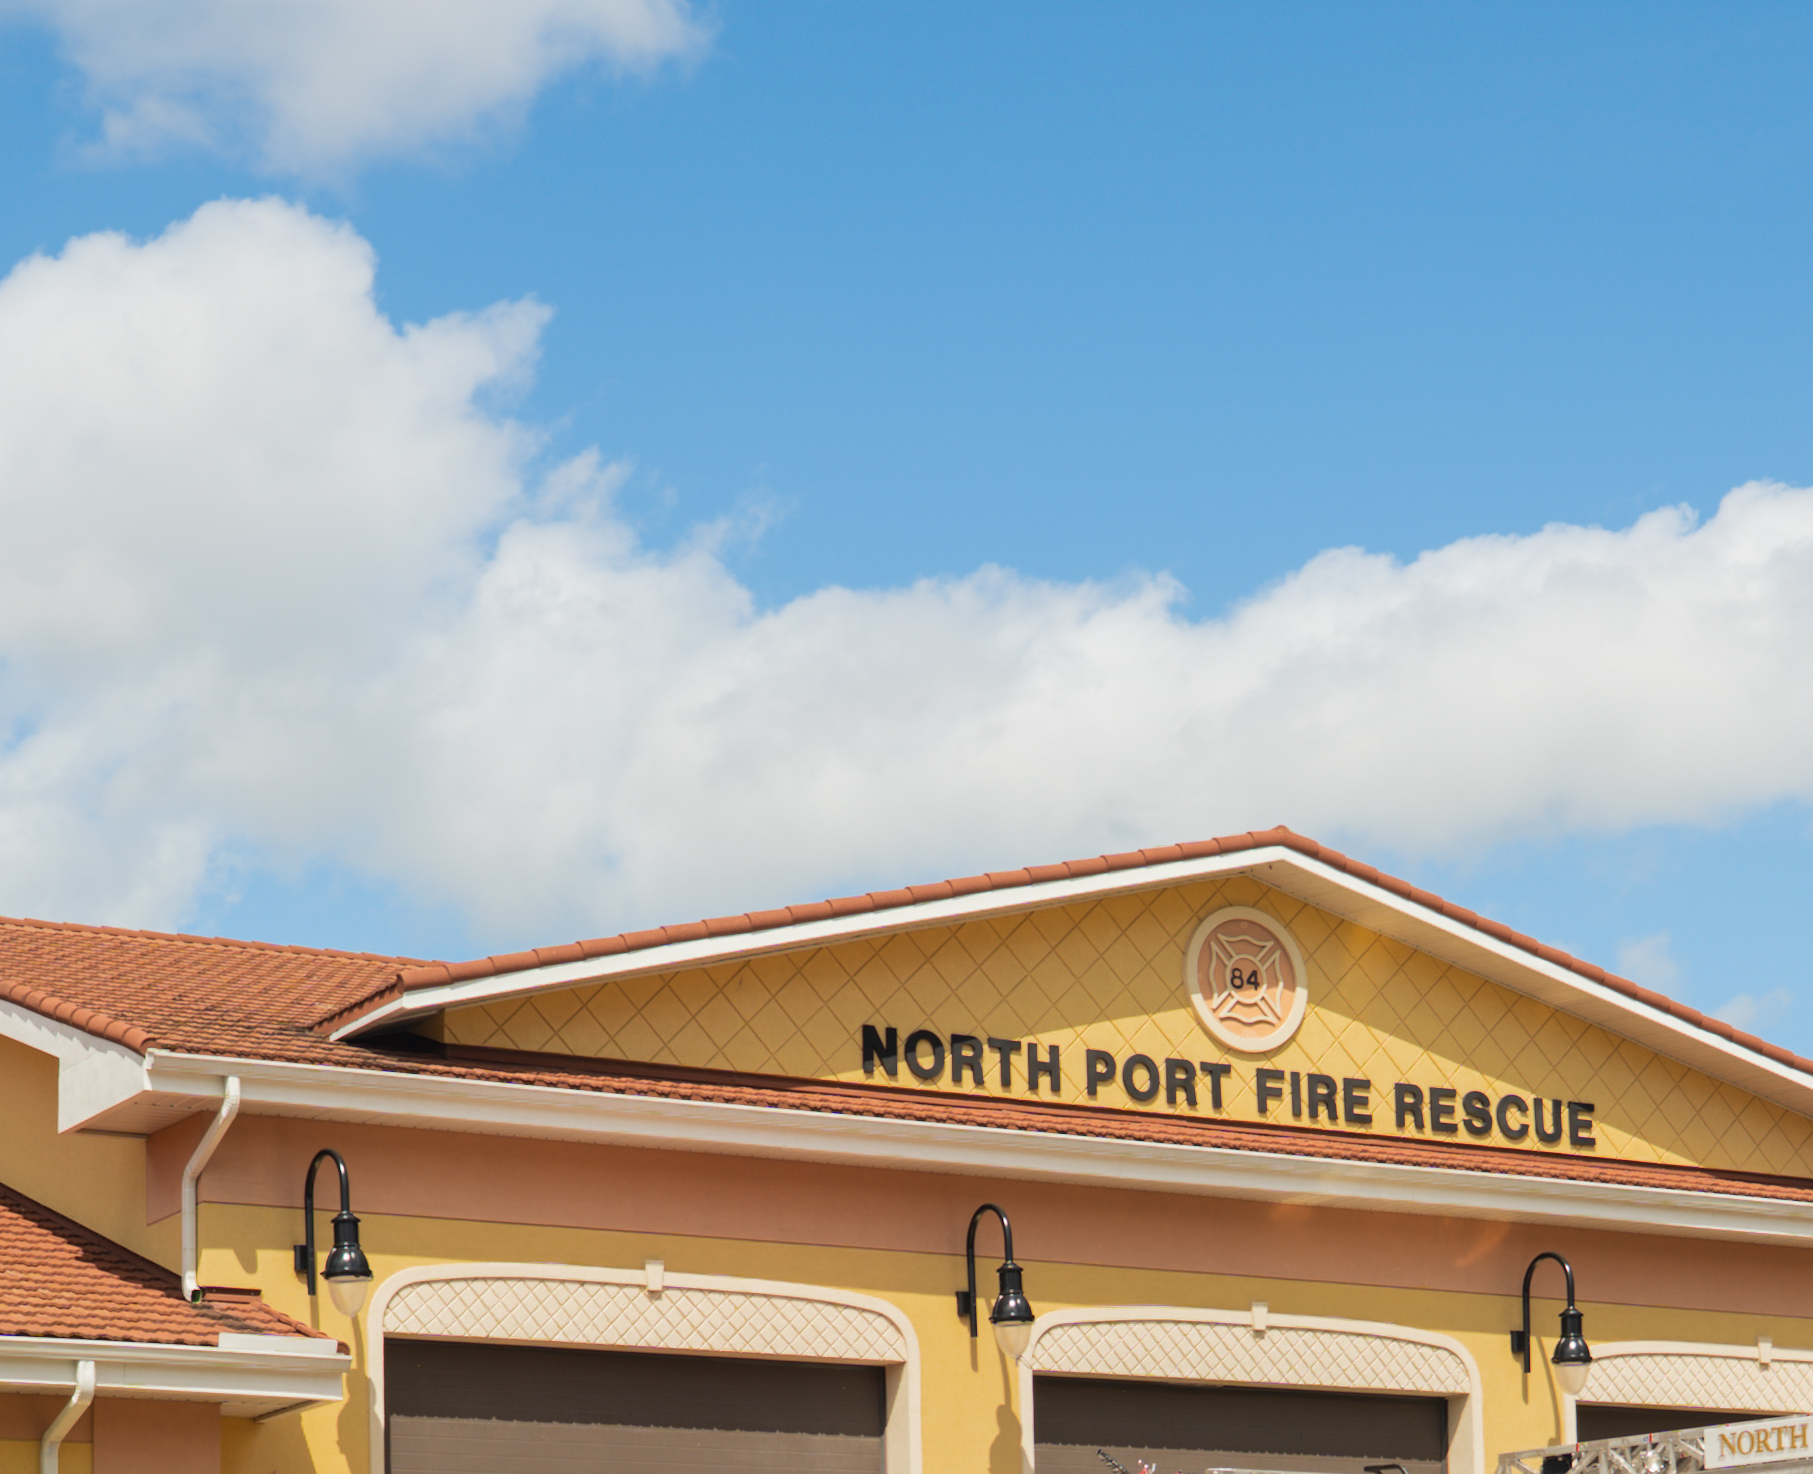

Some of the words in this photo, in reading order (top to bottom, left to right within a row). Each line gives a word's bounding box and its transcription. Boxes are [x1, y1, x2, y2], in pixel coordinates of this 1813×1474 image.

[1230, 968, 1260, 991] 84
[862, 1025, 1061, 1092] NORTH
[1087, 1049, 1232, 1109] PORT
[1256, 1068, 1372, 1124] FIRE
[1394, 1083, 1596, 1147] RESCUE
[1718, 1423, 1808, 1458] NORTH
